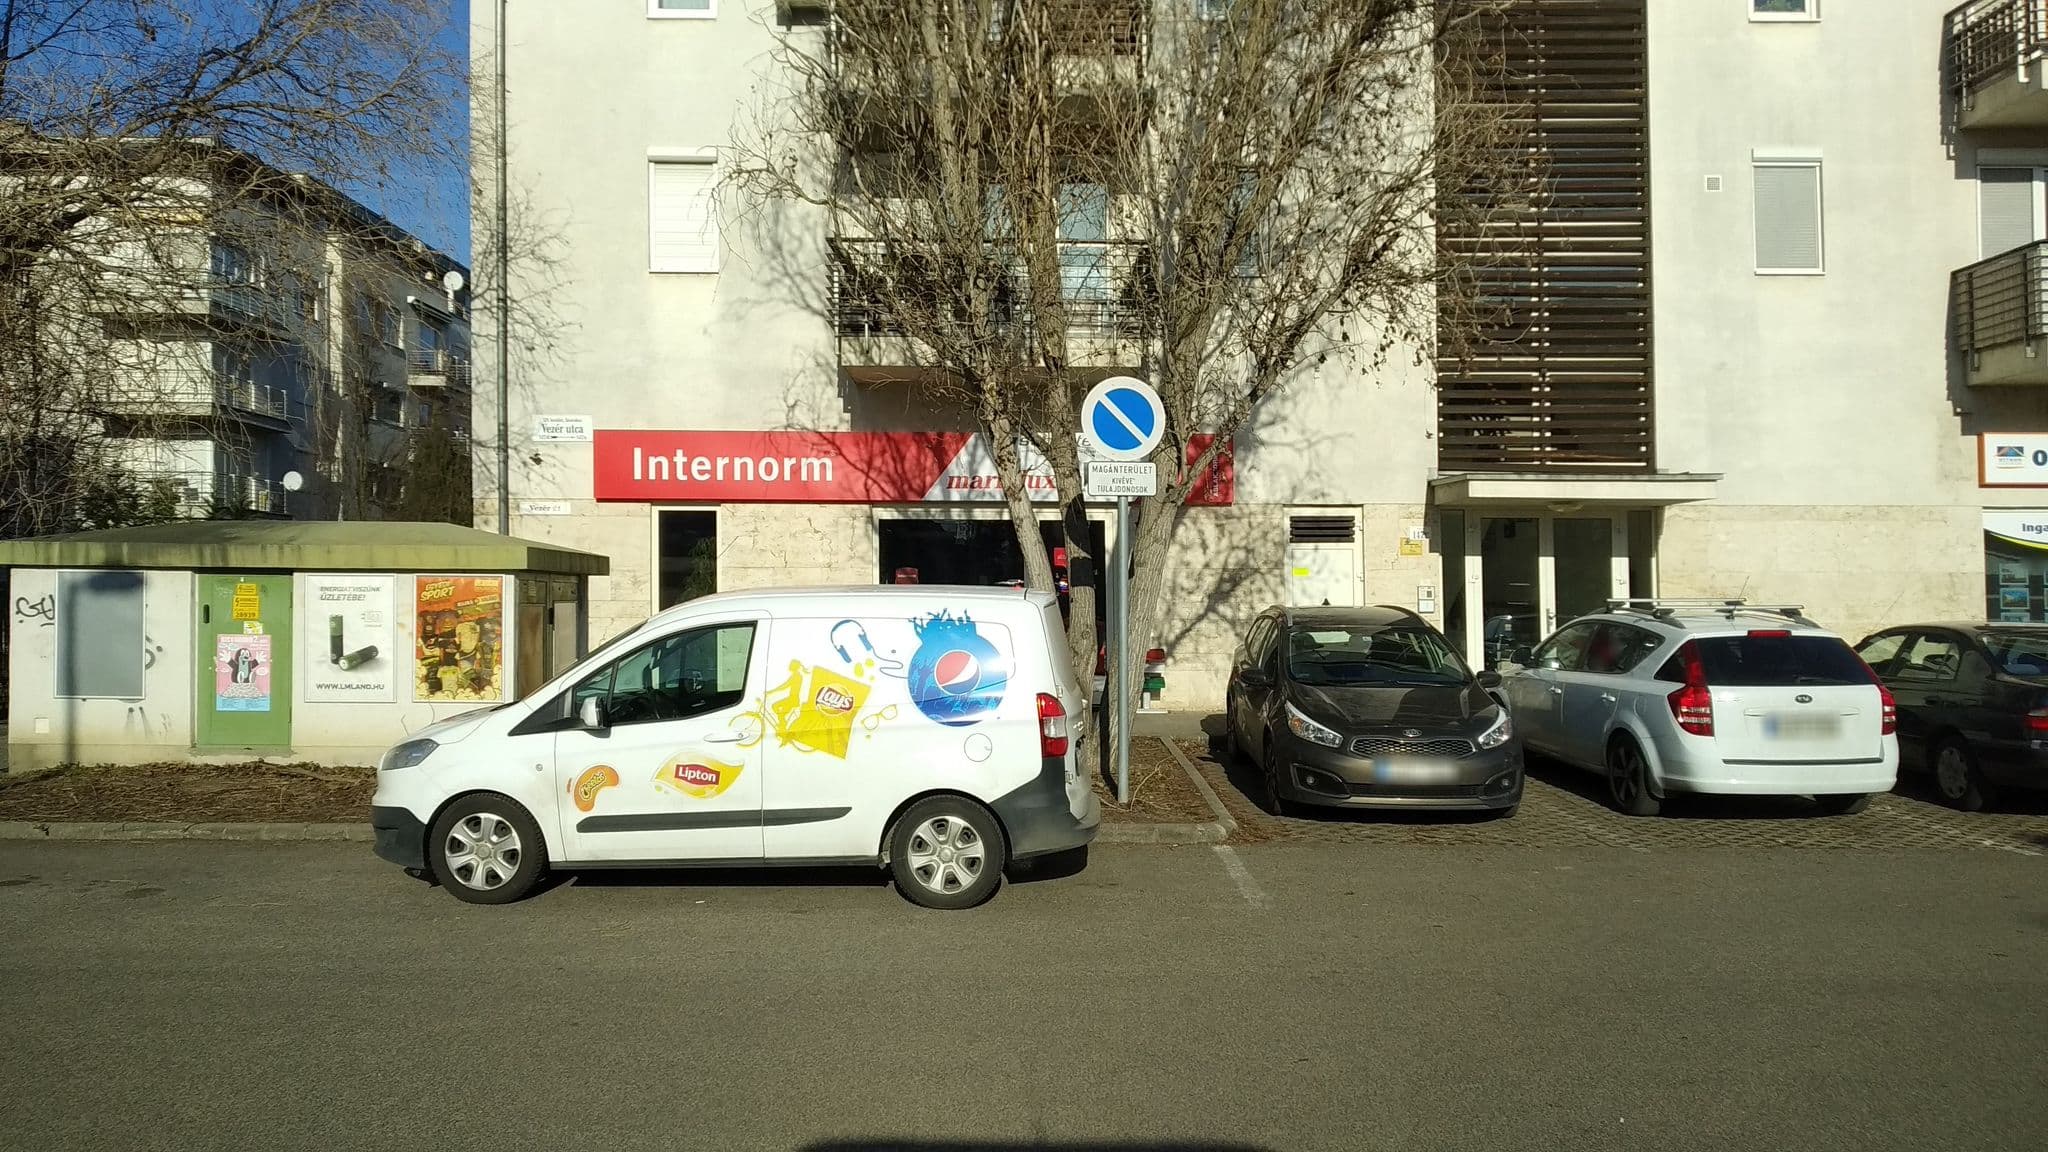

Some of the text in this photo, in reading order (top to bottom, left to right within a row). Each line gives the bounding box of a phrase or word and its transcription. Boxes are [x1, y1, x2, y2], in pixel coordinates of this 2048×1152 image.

[541, 423, 584, 433] Vezér utca
[633, 447, 833, 481] Internorm
[1092, 464, 1153, 474] MAGÁNTERÜLET
[1097, 485, 1148, 493] TULAJDONOSOK
[420, 586, 455, 601] SPORT
[678, 766, 717, 782] Lipton
